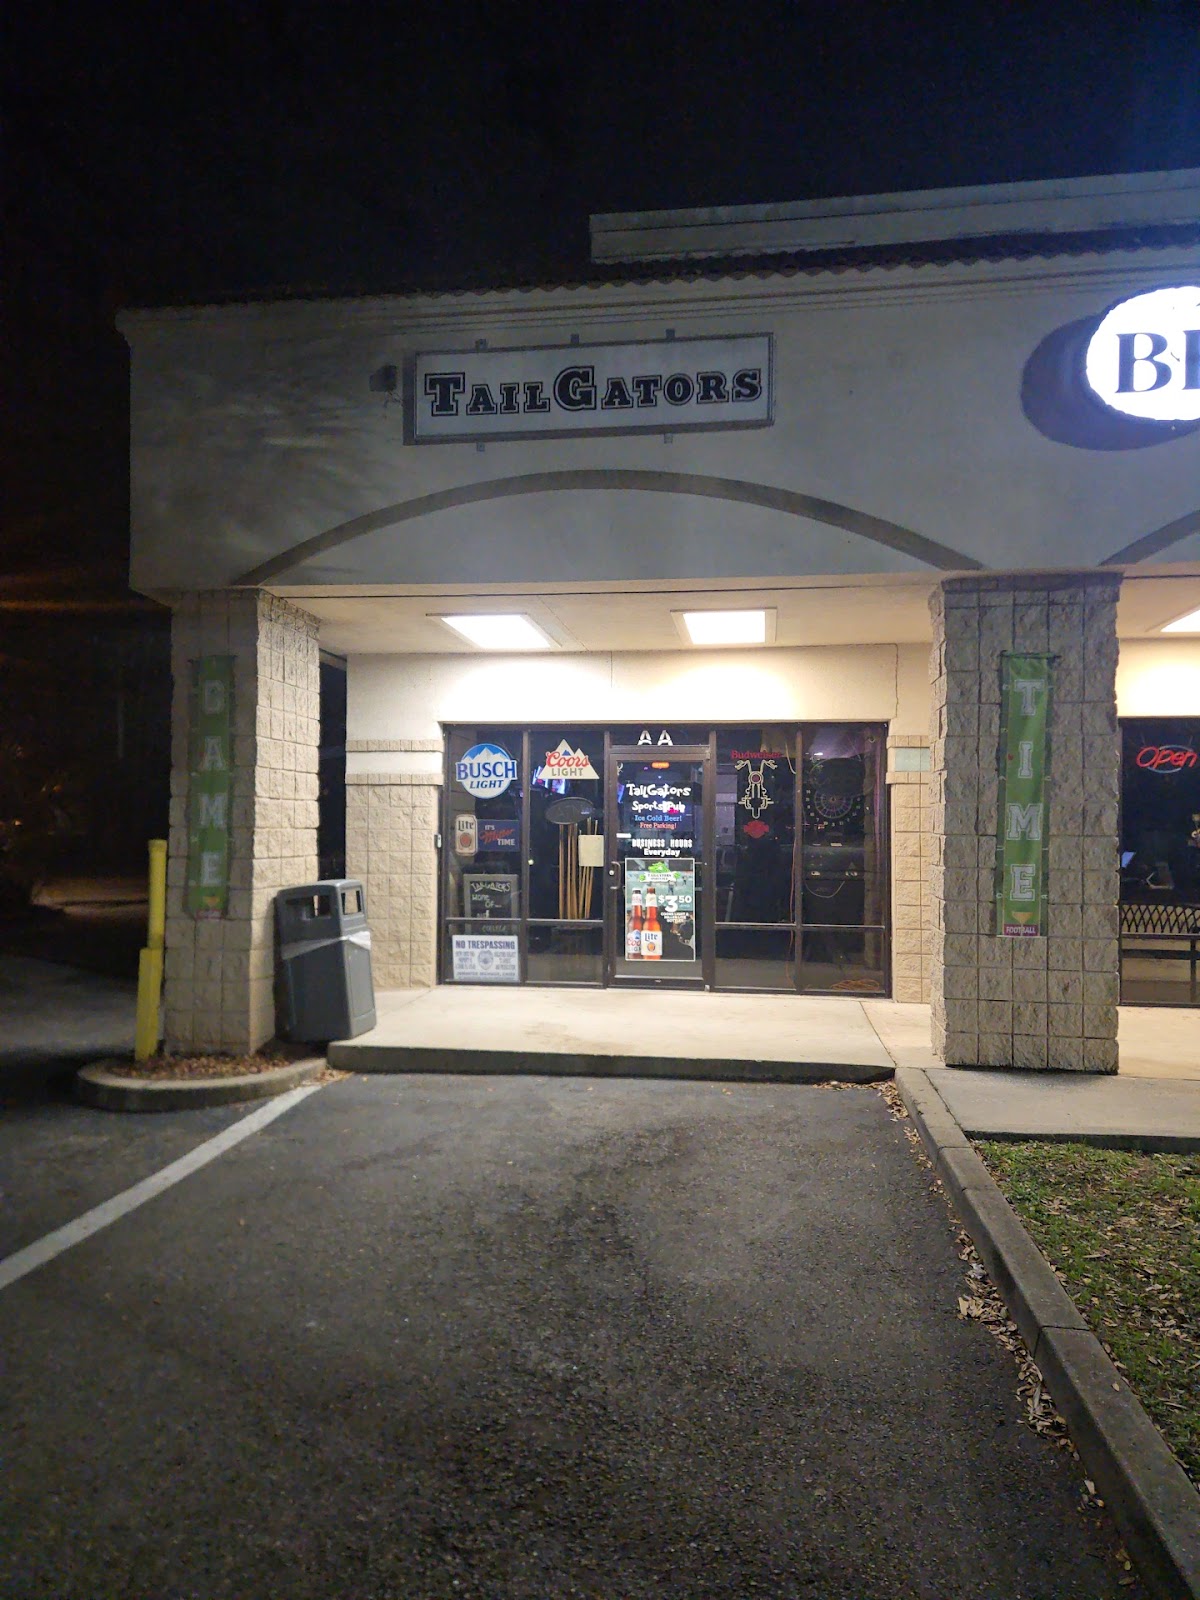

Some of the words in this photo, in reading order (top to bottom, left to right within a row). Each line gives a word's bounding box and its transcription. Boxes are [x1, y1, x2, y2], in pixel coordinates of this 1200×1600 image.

[546, 751, 590, 767] Coors
[731, 750, 782, 759] Budweiser
[1136, 746, 1197, 769] Open
[456, 761, 516, 781] BUSCH
[551, 768, 584, 777] LIGHT
[469, 779, 505, 789] LIGHT
[1006, 679, 1044, 901] TIME
[632, 801, 663, 813] Sports
[458, 821, 474, 831] Lite
[654, 822, 677, 830] Parking!
[497, 838, 515, 846] TIME
[644, 848, 681, 857] Everyday
[1006, 926, 1036, 934] FOOTBALL
[455, 940, 466, 949] NO
[468, 940, 515, 949] TRESPASSING
